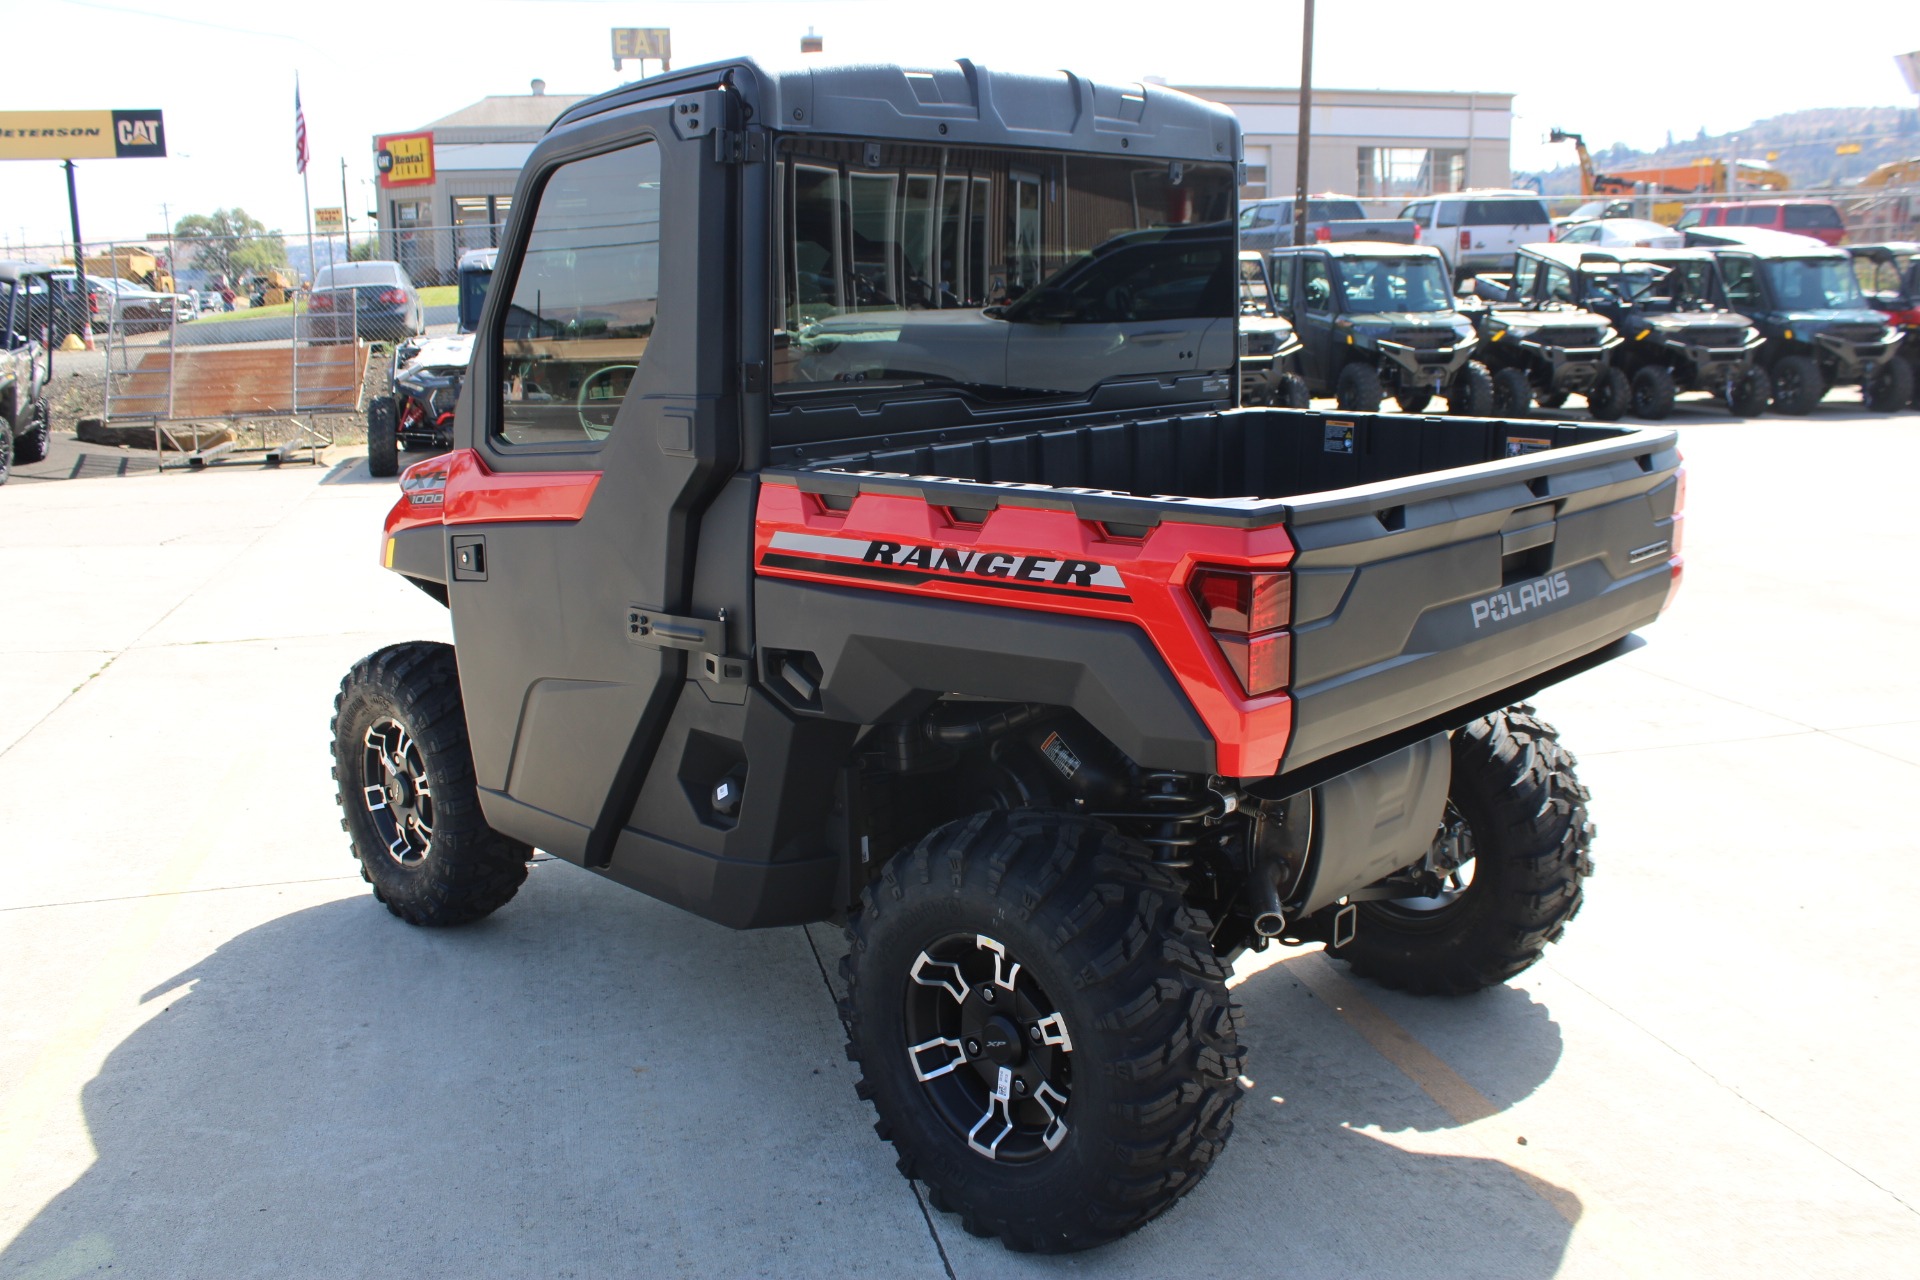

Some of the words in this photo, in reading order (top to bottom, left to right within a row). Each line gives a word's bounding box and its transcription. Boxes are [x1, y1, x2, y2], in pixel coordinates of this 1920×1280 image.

[615, 29, 668, 55] EAT
[117, 120, 159, 145] CAT
[395, 153, 424, 164] Rental
[412, 494, 444, 504] 1000
[862, 540, 1101, 588] RANGER
[1471, 571, 1570, 628] POLARIS
